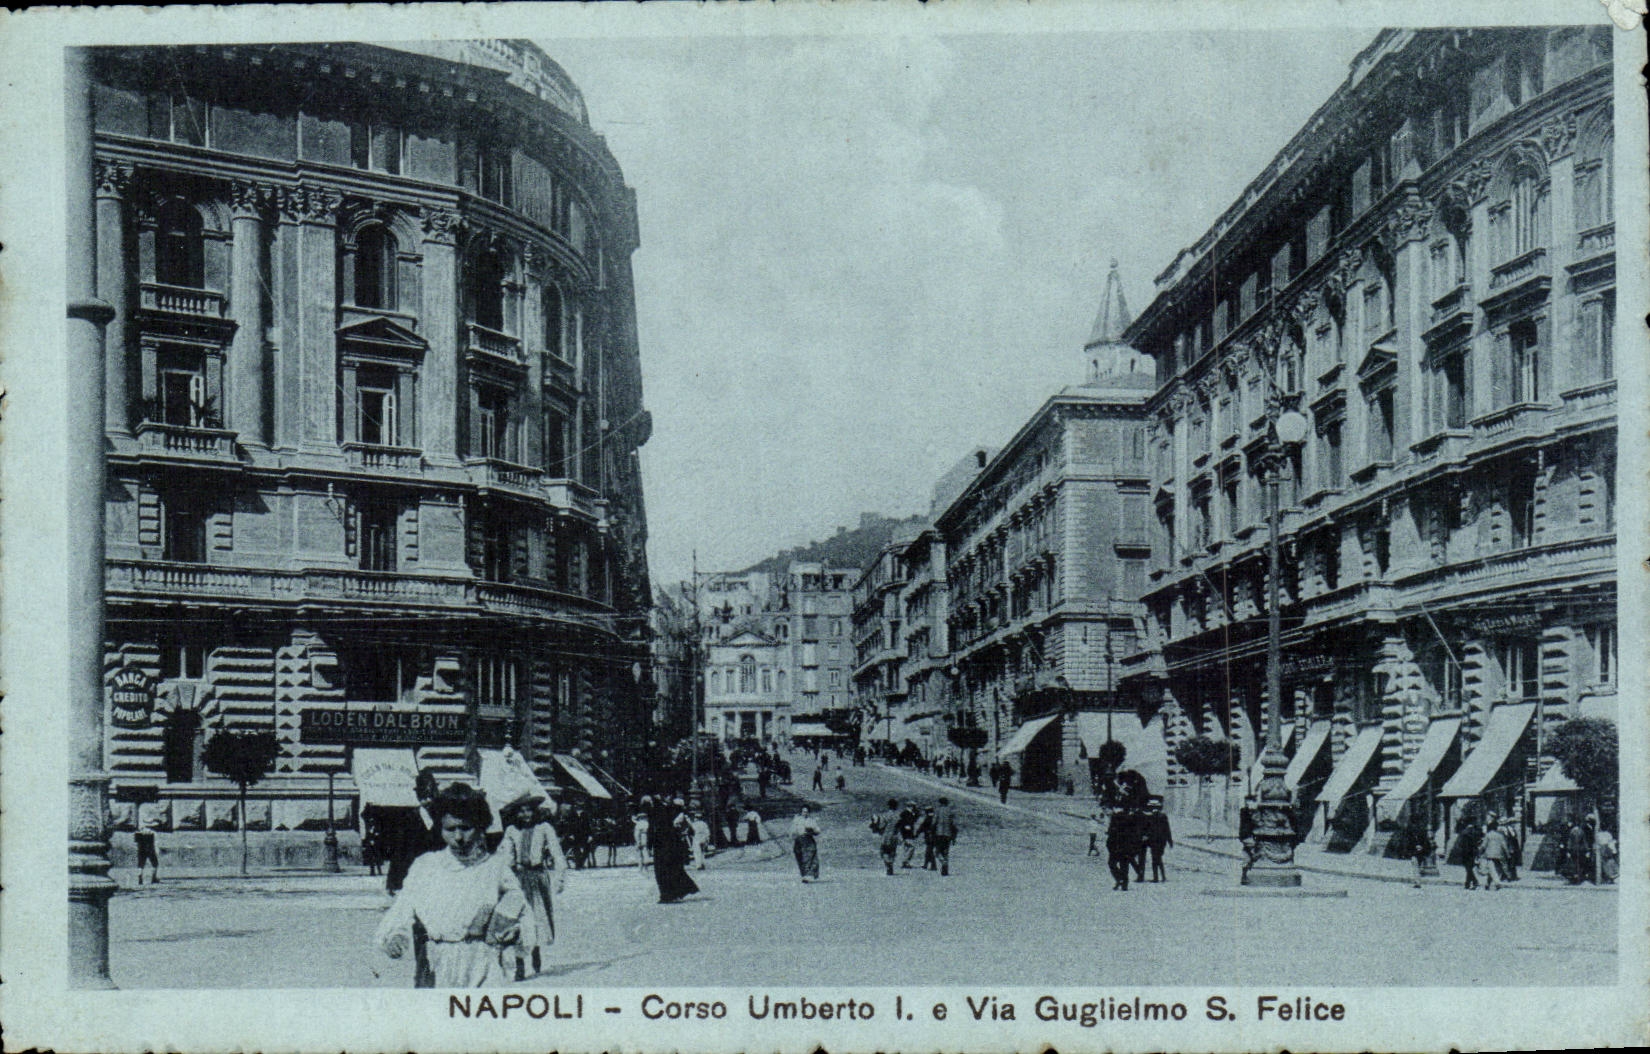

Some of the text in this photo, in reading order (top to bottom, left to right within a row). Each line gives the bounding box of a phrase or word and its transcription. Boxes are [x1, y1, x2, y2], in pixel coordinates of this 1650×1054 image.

[114, 672, 147, 688] BANCA
[113, 691, 149, 703] CREDITO
[311, 711, 367, 727] LODEN
